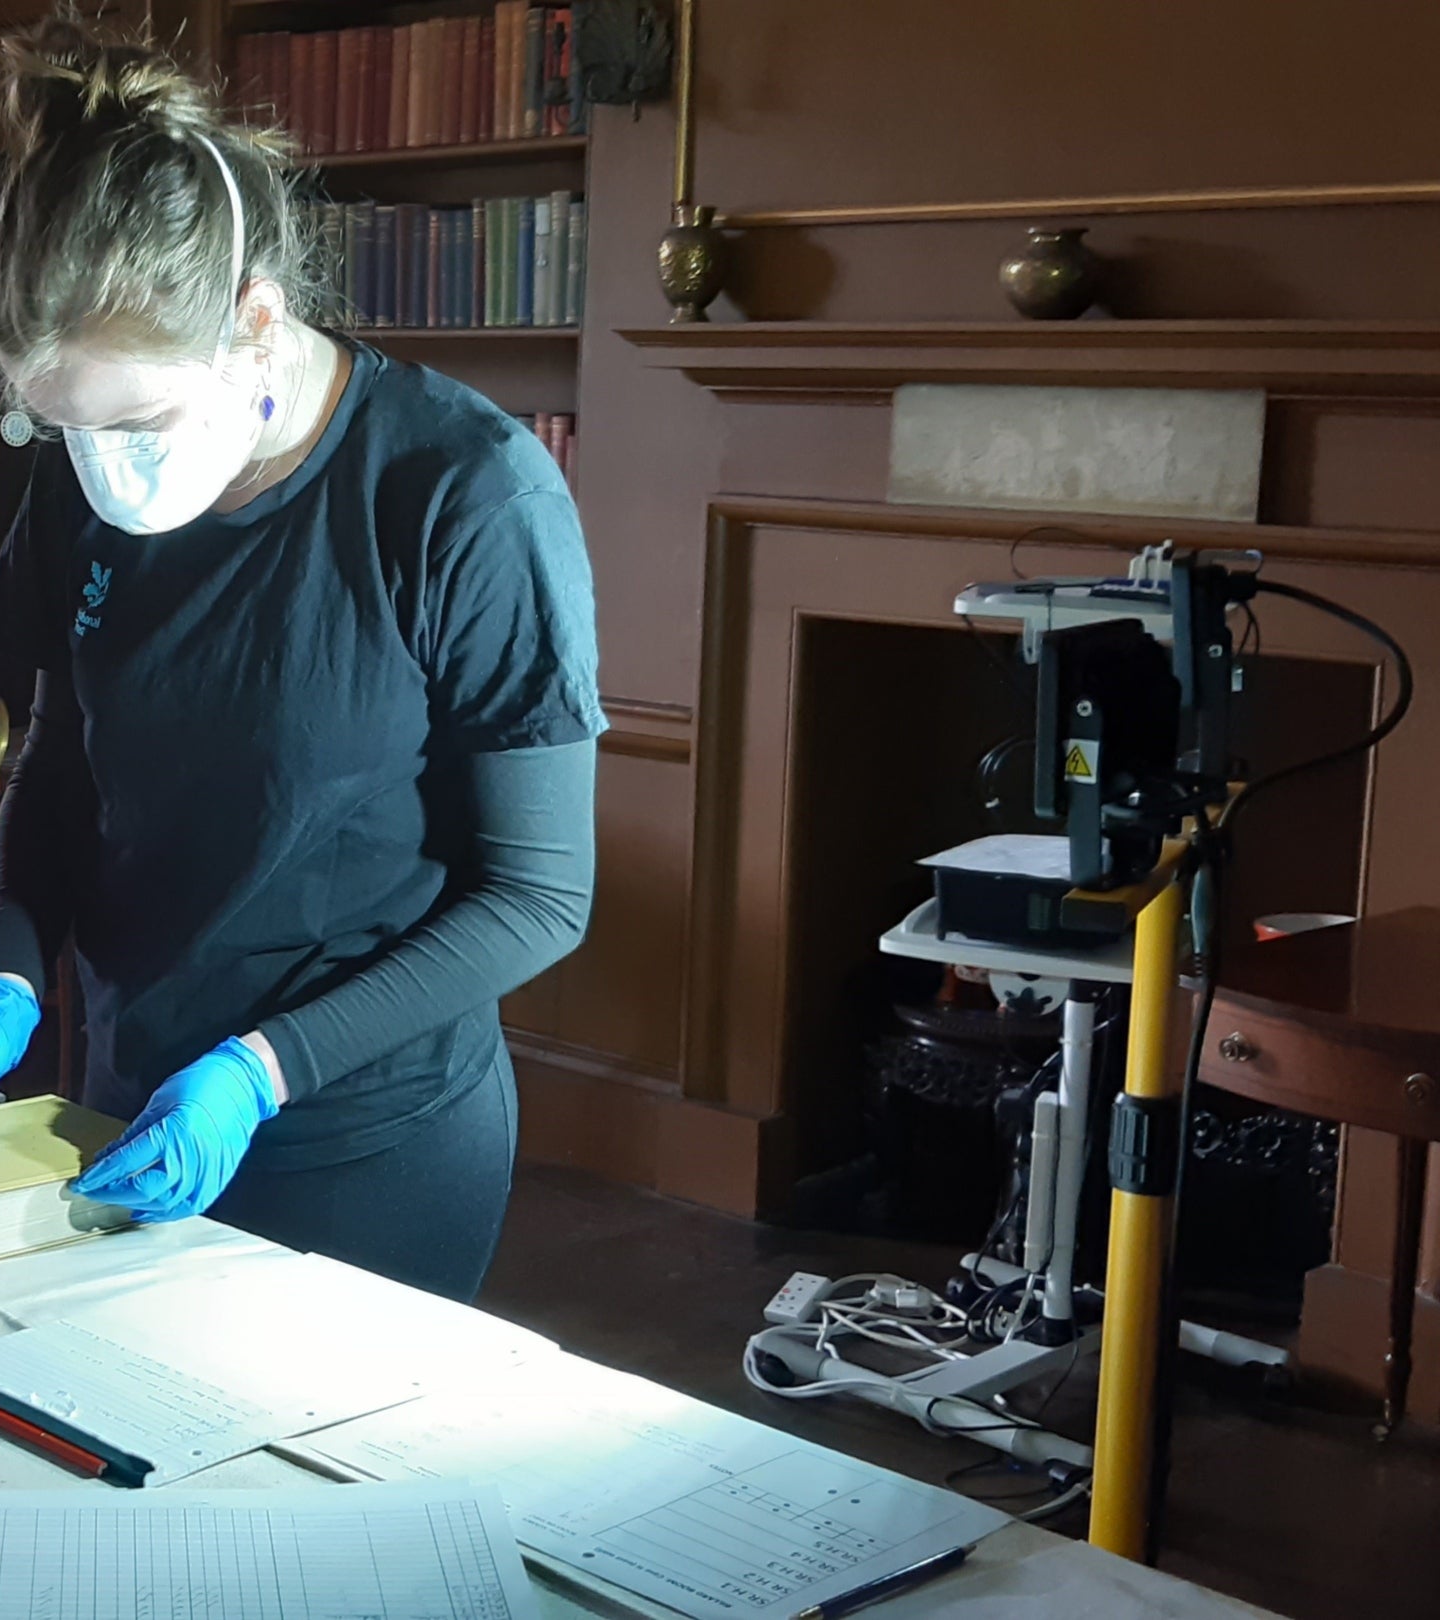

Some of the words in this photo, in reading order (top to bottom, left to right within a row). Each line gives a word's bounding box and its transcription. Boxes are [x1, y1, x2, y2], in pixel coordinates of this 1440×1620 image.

[767, 1561, 817, 1583] SR.H.3
[790, 1552, 839, 1573] SR.H.4
[720, 1582, 769, 1605] SR.H.1
[743, 1572, 793, 1595] SR.H.2
